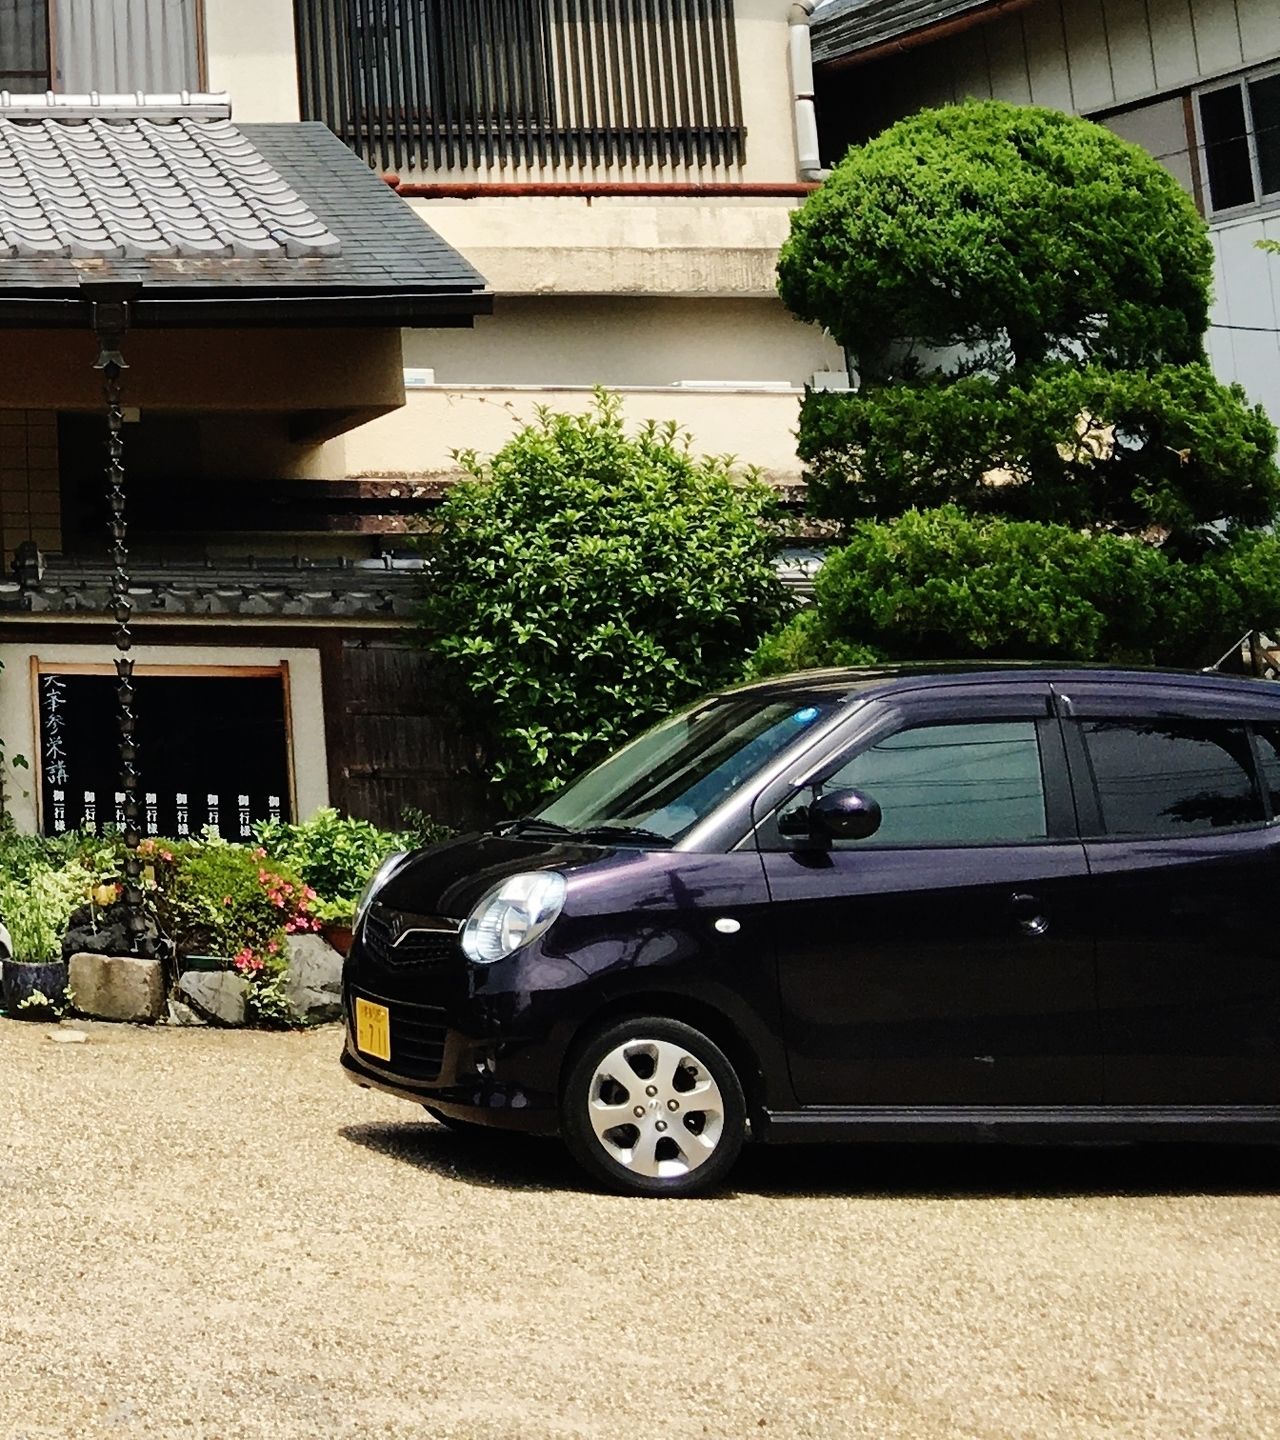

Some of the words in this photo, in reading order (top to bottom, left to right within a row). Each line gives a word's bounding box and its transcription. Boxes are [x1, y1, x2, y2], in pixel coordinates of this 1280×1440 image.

[53, 790, 66, 831] 御一行様
[146, 793, 158, 834] 御一行様
[176, 793, 189, 835] 御一行様
[238, 795, 251, 836] 御一行様
